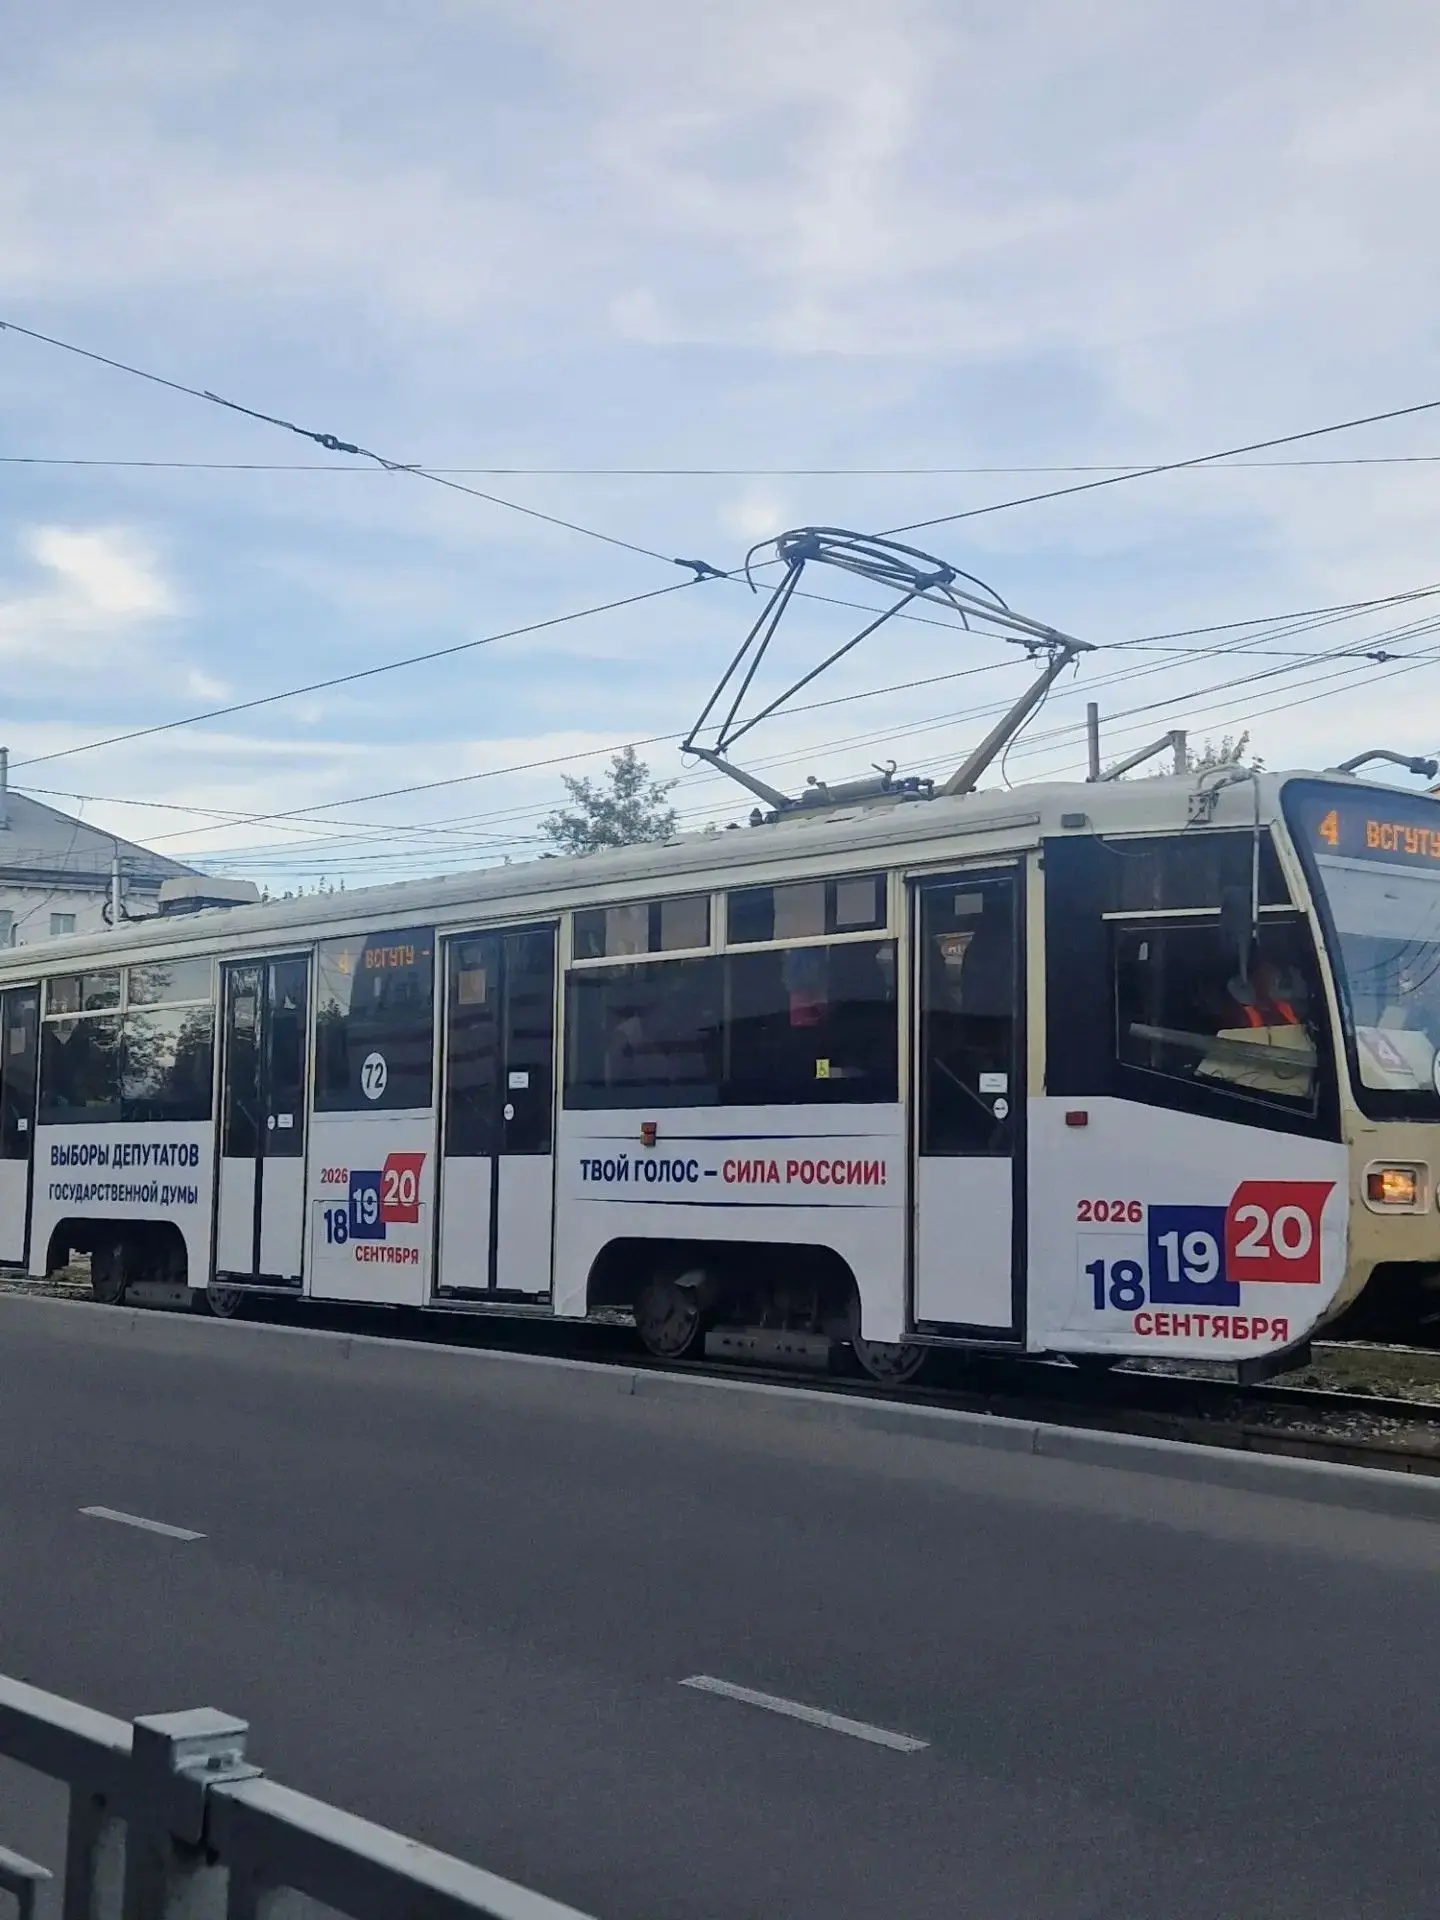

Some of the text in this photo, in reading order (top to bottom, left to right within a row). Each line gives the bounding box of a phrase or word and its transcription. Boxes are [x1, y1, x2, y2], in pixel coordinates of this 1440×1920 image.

[1319, 810, 1440, 858] 4 ВСГУТУ
[365, 1062, 383, 1089] 72
[50, 1143, 199, 1169] ВЫБОРЫ ДЕПУТАТОВ
[580, 1154, 628, 1182] ТВОЙ
[634, 1159, 699, 1183] ГОЛОС
[723, 1159, 780, 1184] СИЛА
[786, 1160, 887, 1185] РОССИИ!
[320, 1168, 348, 1184] 2026
[383, 1169, 416, 1207] 20
[49, 1180, 198, 1206] ГОСУДАРСТВЕННОЙ ДУМЫ
[353, 1188, 378, 1225] 19
[324, 1208, 348, 1244] 18
[1077, 1200, 1142, 1223] 2026
[1234, 1204, 1313, 1259] 20
[355, 1245, 419, 1265] СЕНТЯБРЯ
[1157, 1231, 1220, 1284] 19
[1085, 1259, 1145, 1312] 18
[1134, 1312, 1289, 1341] СЕНТЯБРЯ
